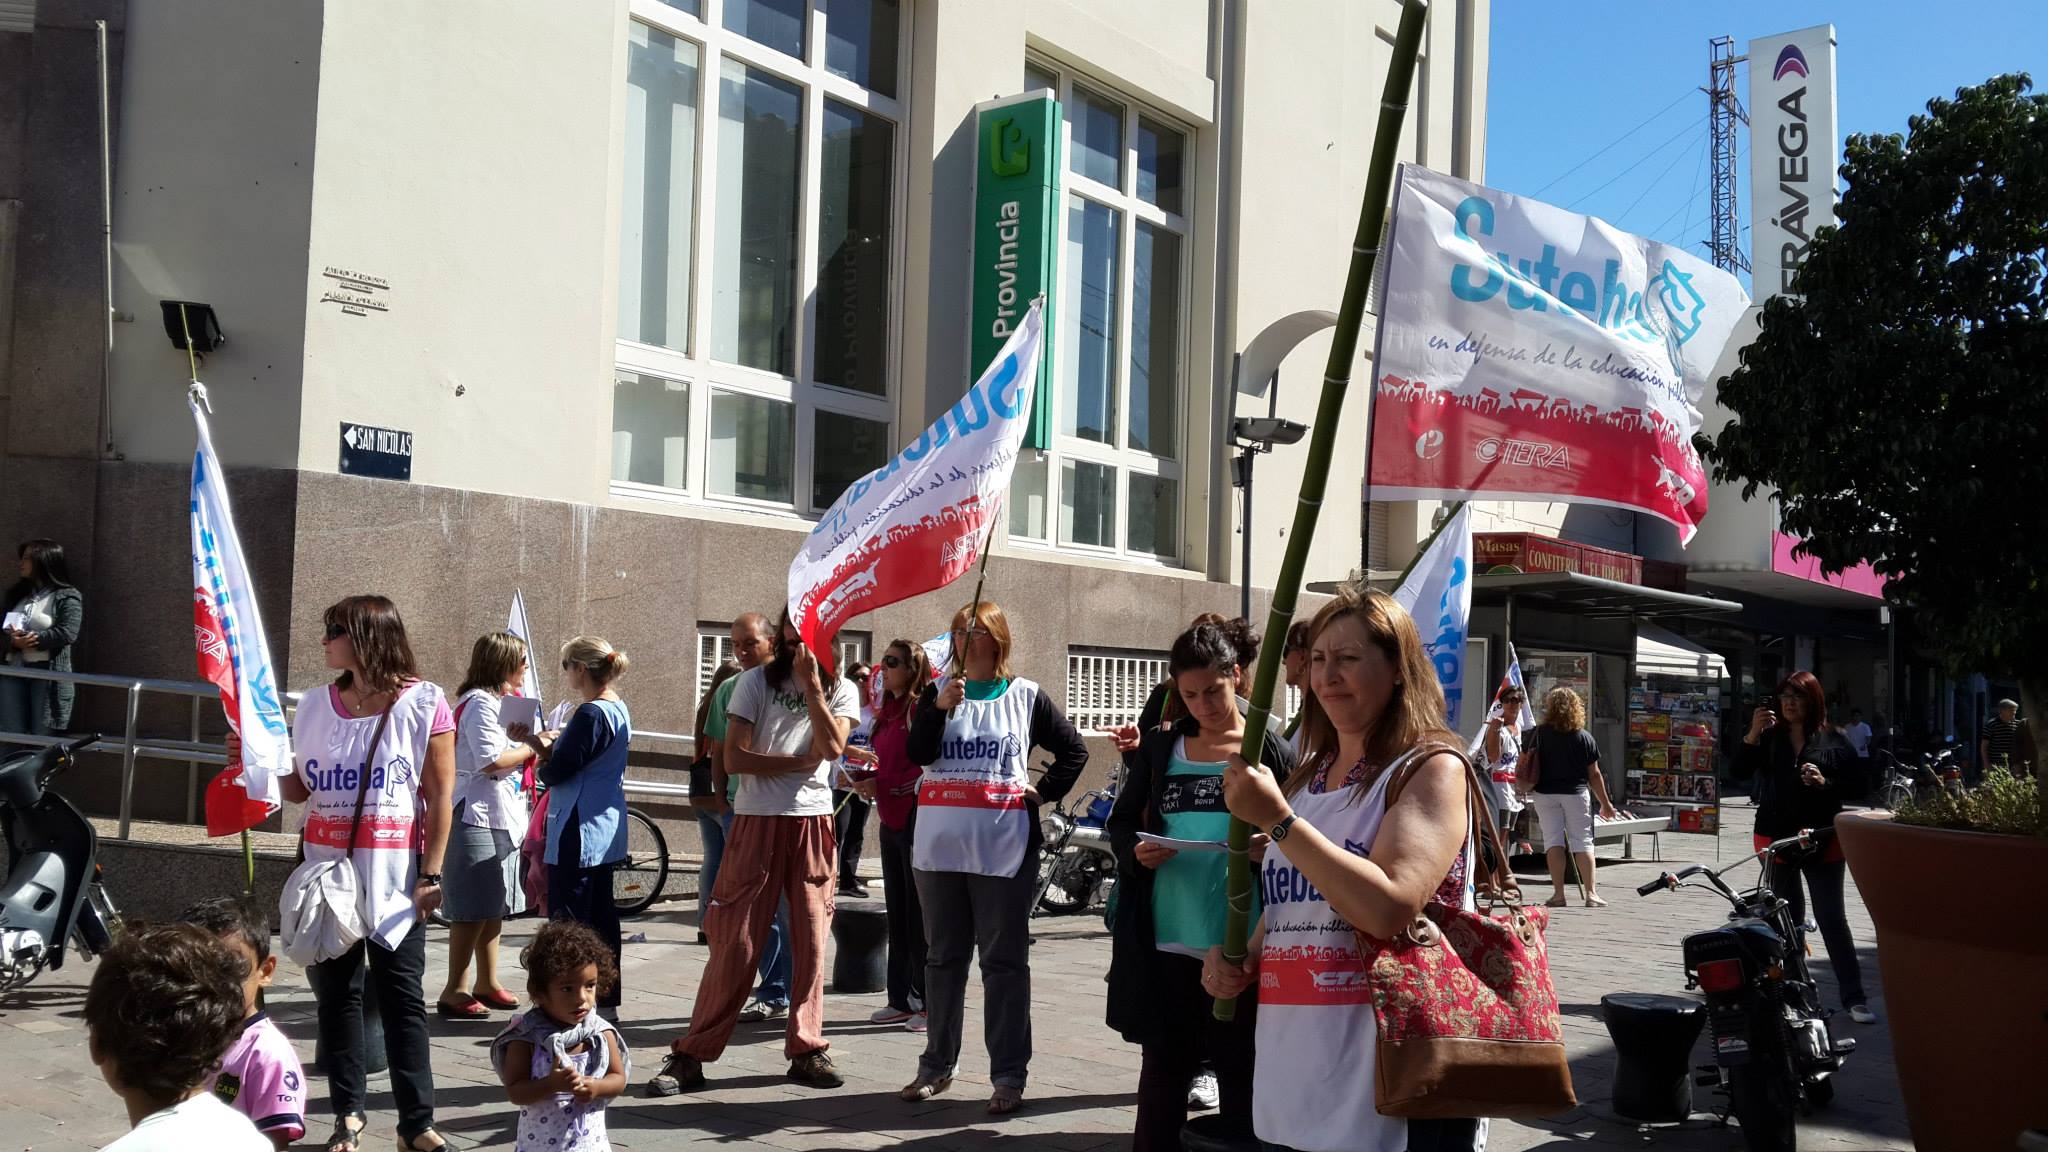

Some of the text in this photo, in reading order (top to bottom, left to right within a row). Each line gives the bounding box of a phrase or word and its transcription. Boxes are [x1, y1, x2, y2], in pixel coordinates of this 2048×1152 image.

[993, 200, 1019, 340] Provincia
[1429, 335, 1449, 350] en
[1455, 331, 1527, 365] defensa
[1534, 343, 1556, 365] de
[1562, 345, 1583, 369] la
[357, 427, 412, 457] SAN NICOLAS
[1475, 437, 1570, 470] CTERA
[1478, 539, 1520, 553] Masas
[942, 736, 1000, 760] uteba
[1163, 798, 1215, 811] TAXI BONDI
